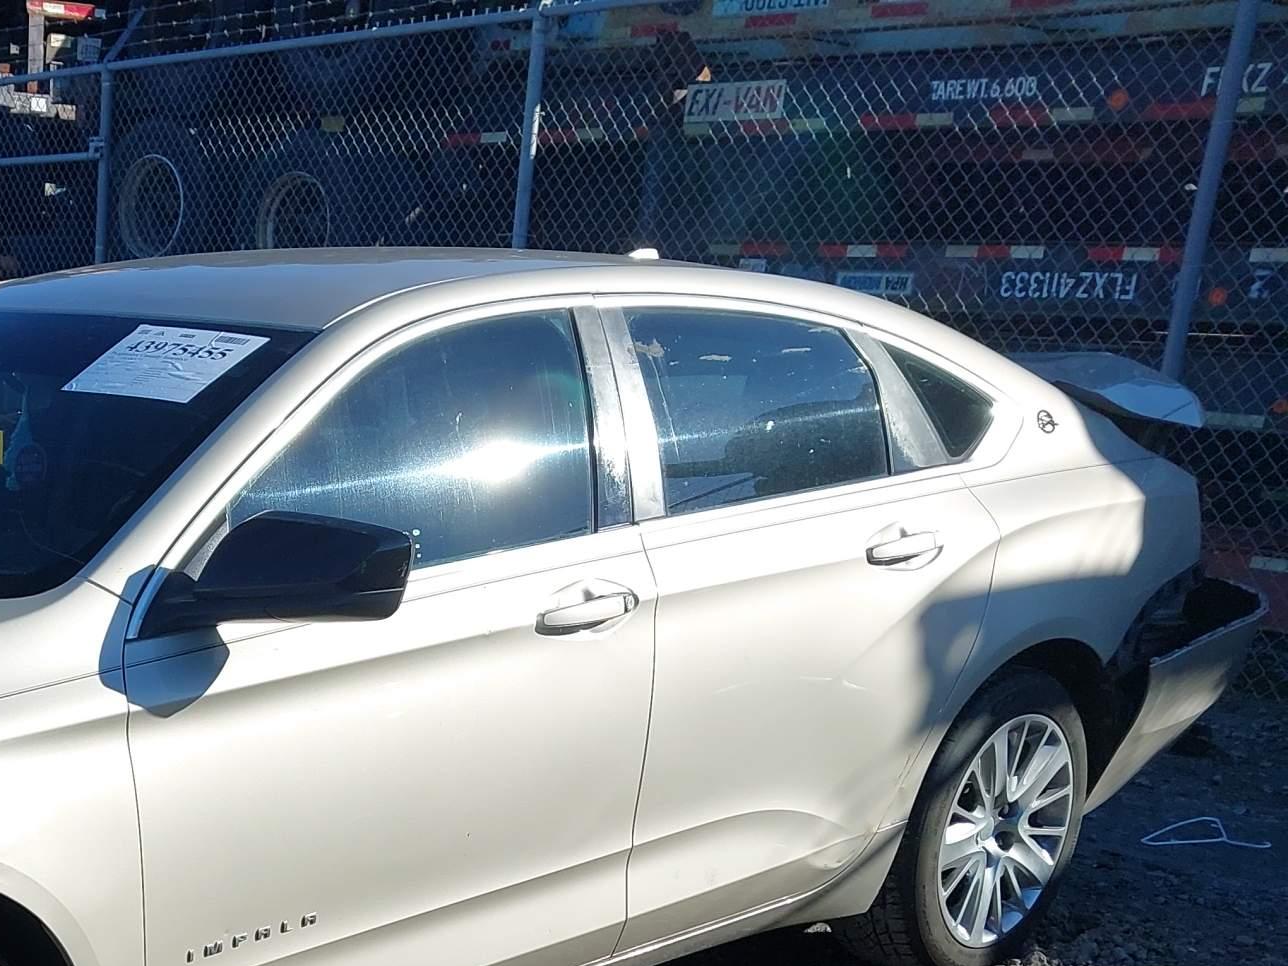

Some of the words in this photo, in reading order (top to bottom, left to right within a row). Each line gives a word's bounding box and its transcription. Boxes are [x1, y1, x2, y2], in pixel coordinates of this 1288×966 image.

[931, 80, 967, 100] TARE
[126, 339, 235, 361] 43975455
[186, 911, 317, 964] IMPALA
